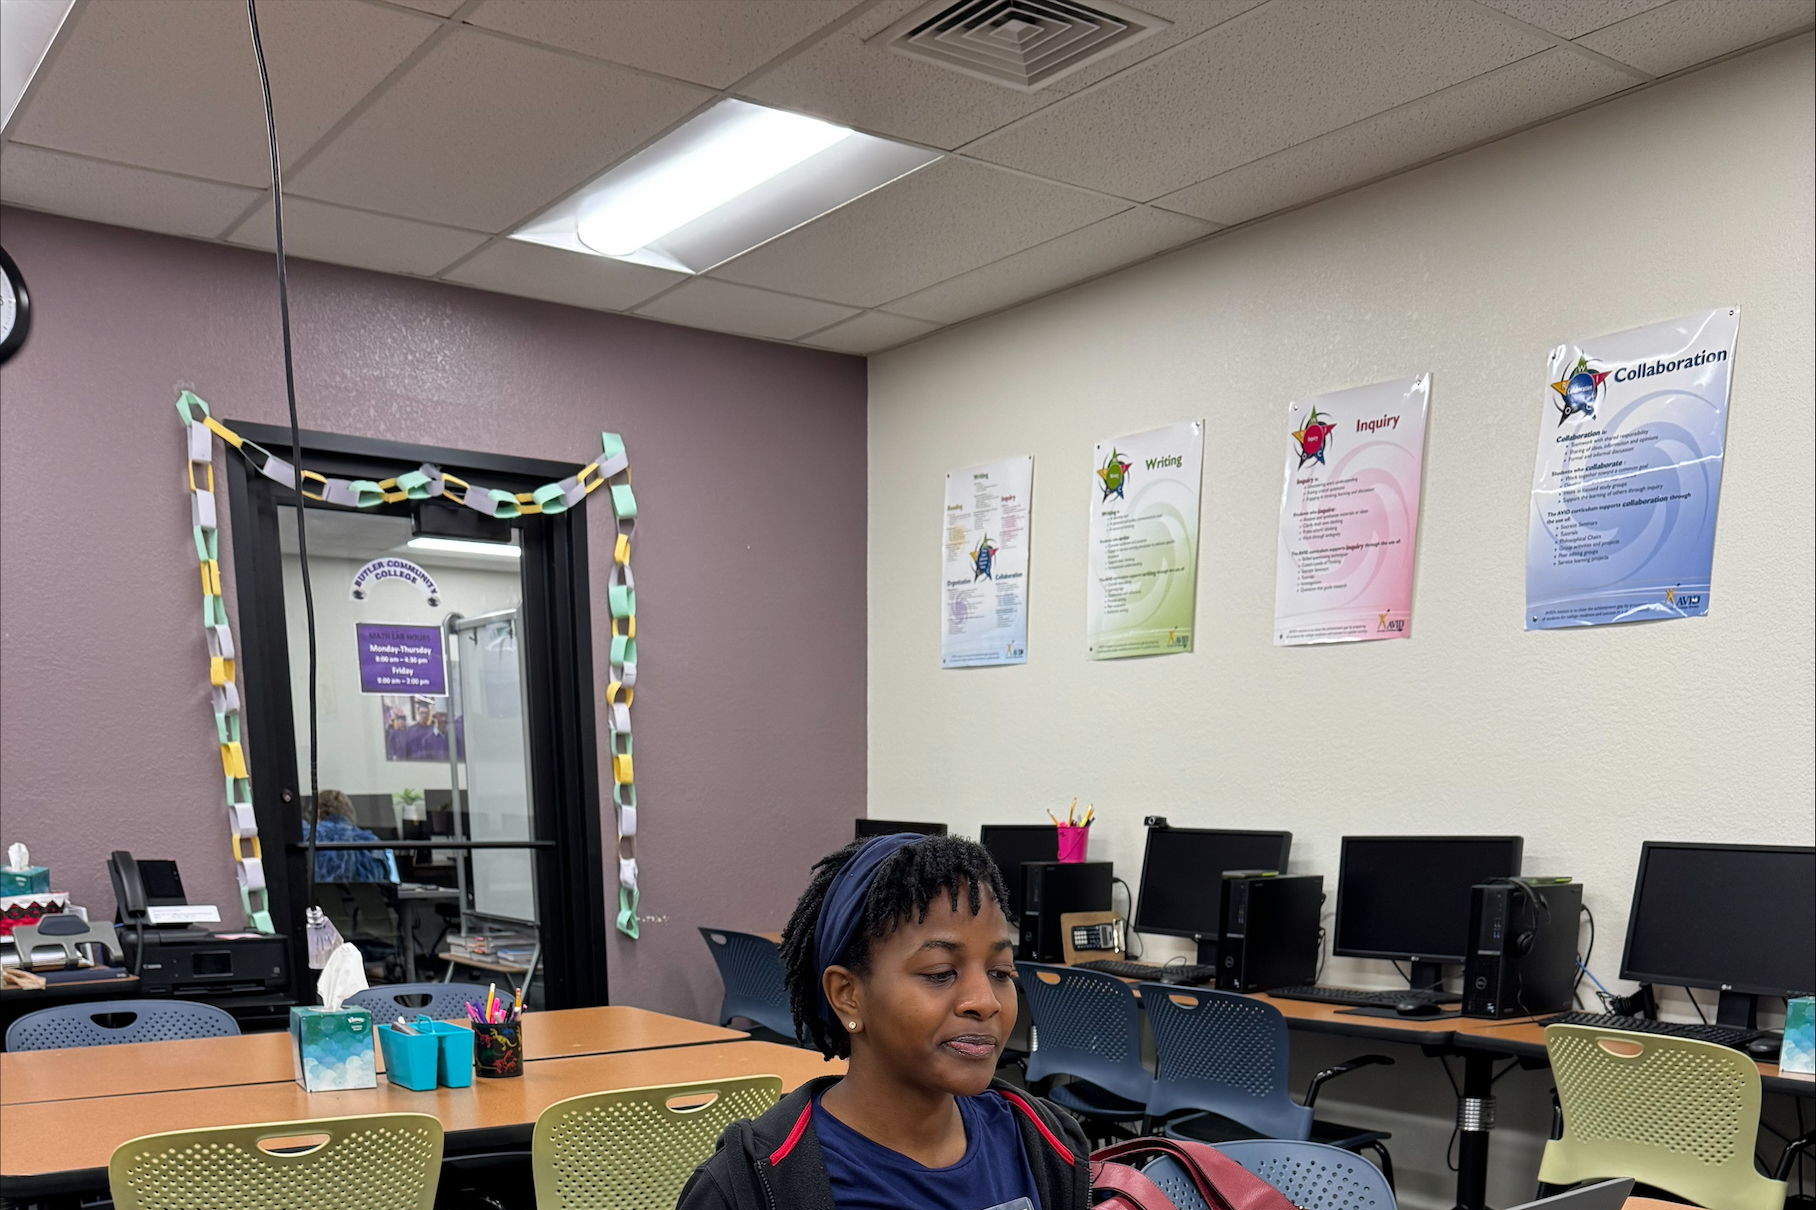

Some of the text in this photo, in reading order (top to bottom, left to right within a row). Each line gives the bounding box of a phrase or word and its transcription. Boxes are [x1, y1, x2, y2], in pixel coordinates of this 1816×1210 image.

[1614, 349, 1728, 383] Collaboration
[1356, 414, 1401, 434] Inquiry
[1556, 430, 1600, 443] Collaboration
[1145, 455, 1182, 471] Writing
[1622, 495, 1668, 507] collaboration
[1669, 491, 1691, 502] through
[354, 560, 438, 594] BUTLER COMMUNITY
[375, 569, 418, 584] COLLEGE
[369, 632, 390, 640] MATH
[407, 634, 430, 642] HOURS
[369, 644, 432, 655] Monday-Thursday
[392, 666, 414, 676] Friday
